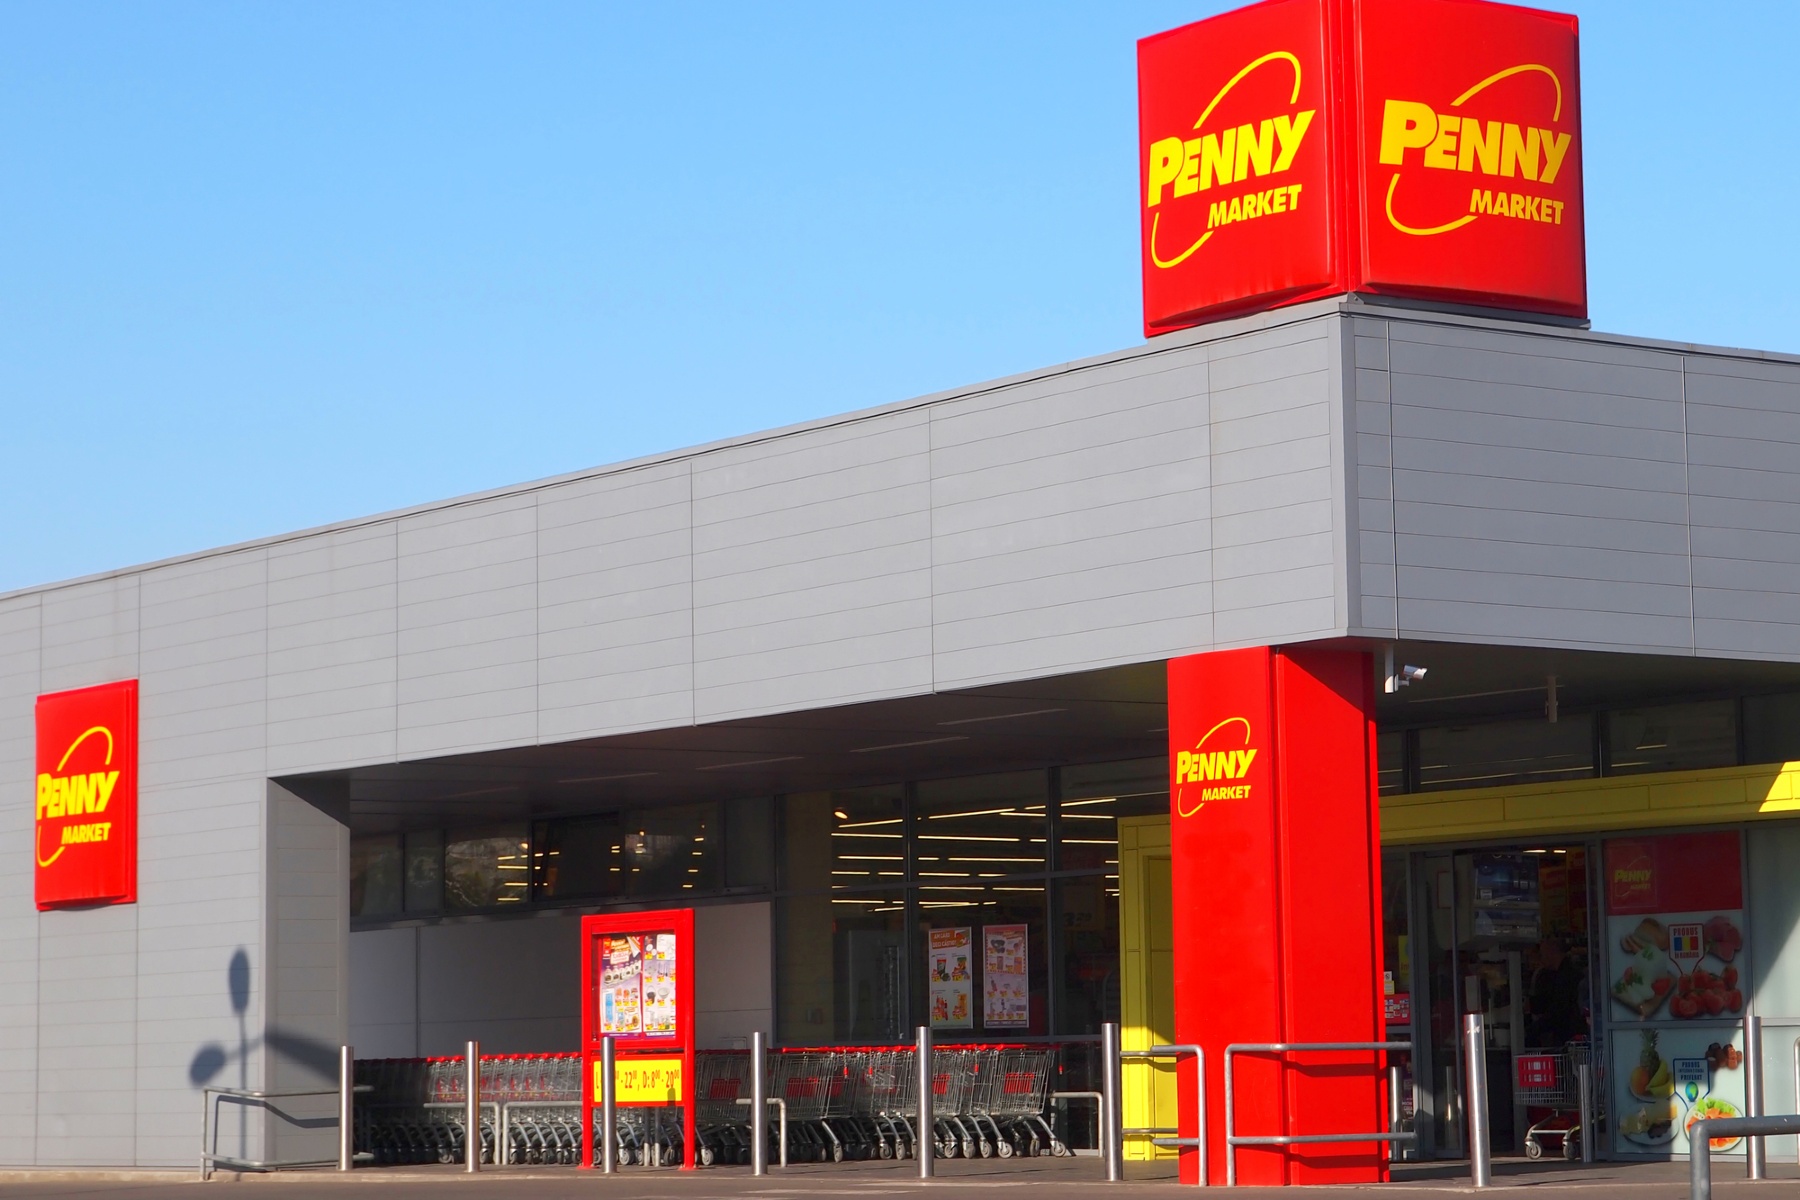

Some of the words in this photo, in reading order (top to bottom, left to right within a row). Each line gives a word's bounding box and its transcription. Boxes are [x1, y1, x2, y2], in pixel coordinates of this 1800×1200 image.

[1379, 99, 1571, 183] PENNY
[1148, 110, 1316, 208] PENNY
[1208, 184, 1302, 229] MARKET
[1470, 189, 1564, 224] MARKET
[1176, 749, 1257, 784] PENNY
[35, 771, 120, 821] PENNY
[1202, 785, 1251, 802] MARKET
[61, 822, 112, 845] MARKET
[1614, 868, 1652, 883] PENNY
[1673, 927, 1699, 936] PRODUS
